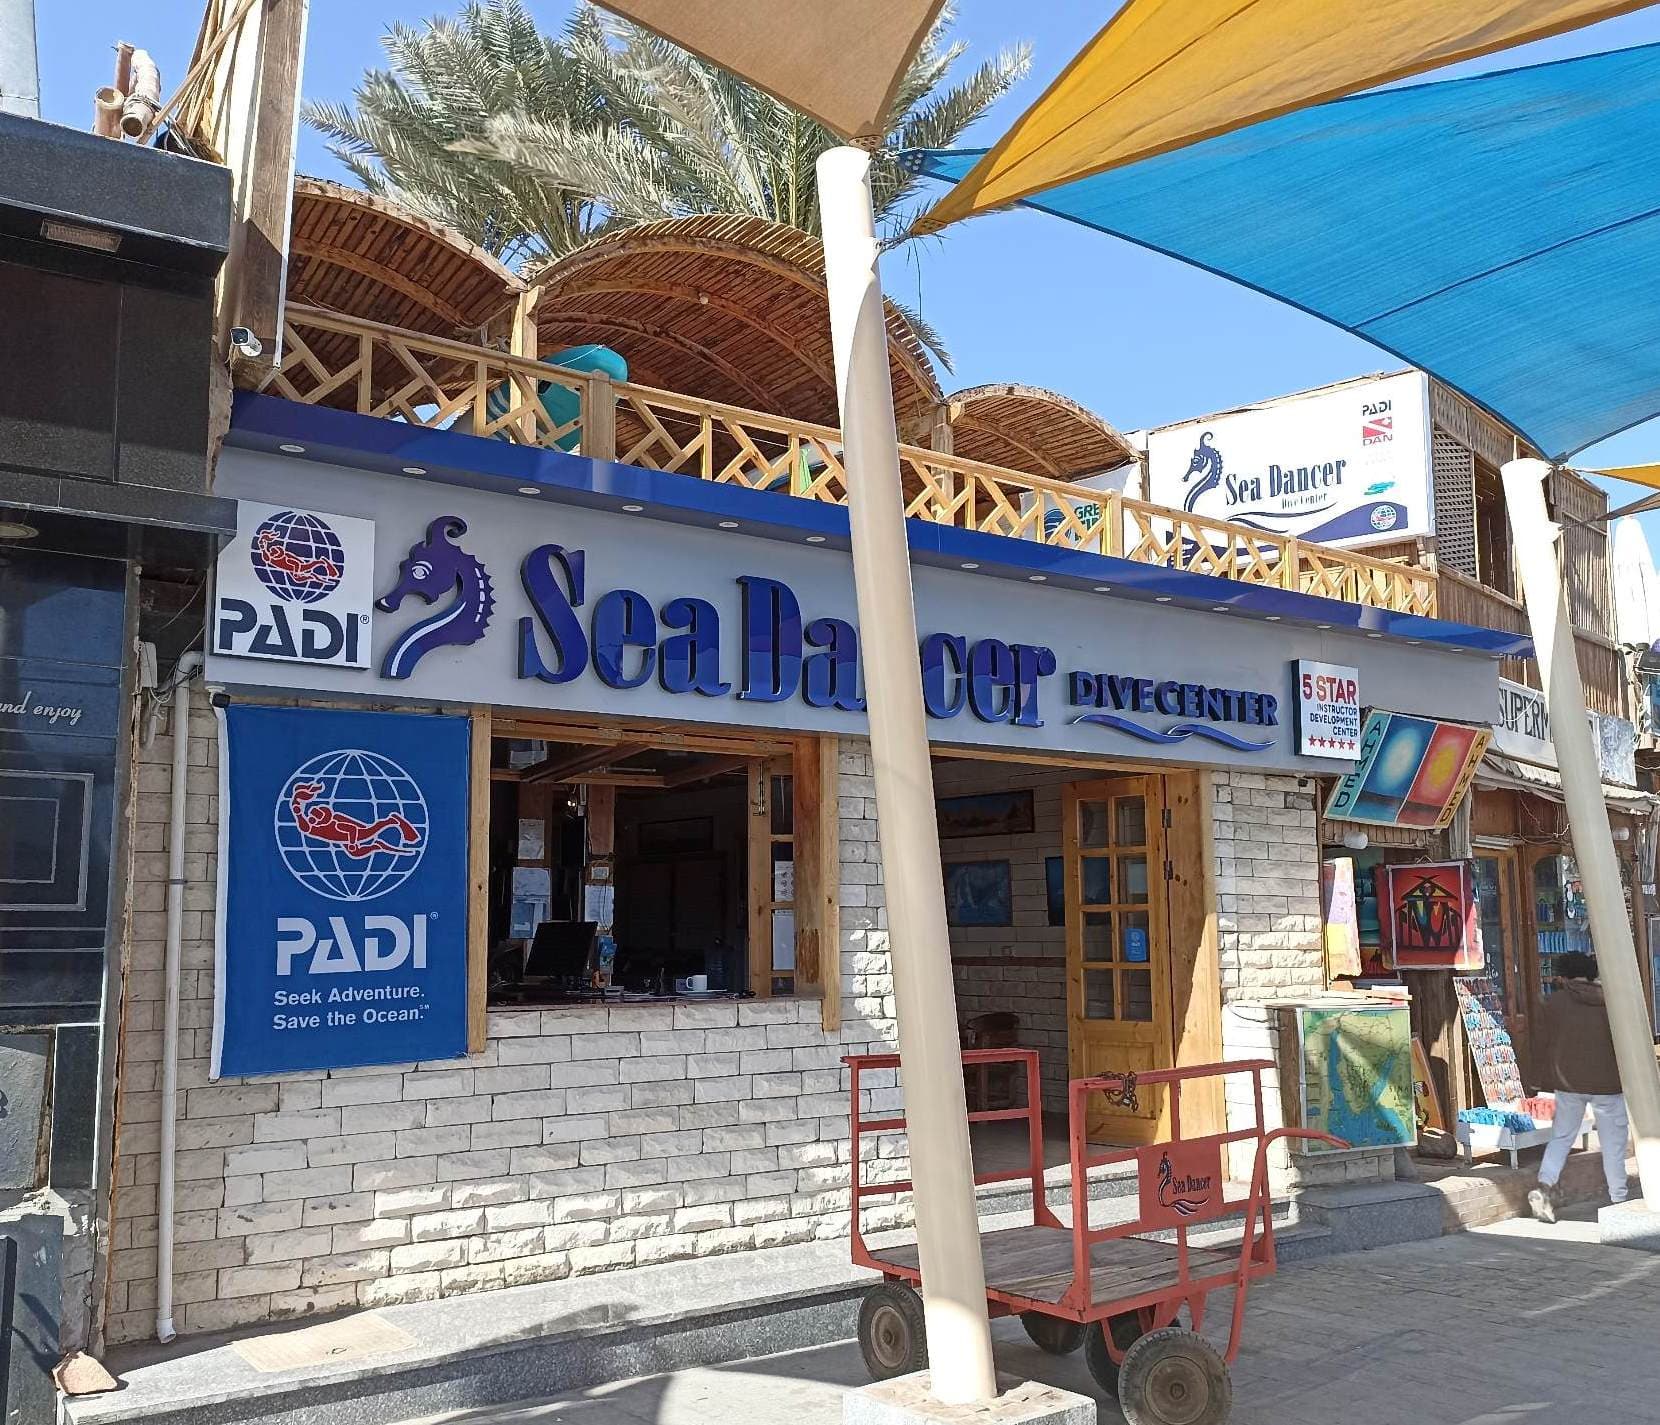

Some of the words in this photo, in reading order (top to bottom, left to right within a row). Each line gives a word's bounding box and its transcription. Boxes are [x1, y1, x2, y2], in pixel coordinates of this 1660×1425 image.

[1362, 399, 1392, 416] PADI
[1363, 434, 1393, 446] DAN
[1225, 473, 1263, 505] Sea
[1269, 460, 1347, 497] Dancer
[517, 543, 731, 698] Sea
[735, 575, 1057, 729] Dacer
[1302, 673, 1313, 700] 5
[1316, 675, 1357, 706] STAR
[33, 704, 82, 726] enjoy
[1309, 712, 1358, 728] DEVELOPMENT
[1316, 703, 1358, 716] INSTRUCTOR
[1332, 726, 1358, 738] CENTER
[1333, 720, 1382, 809] AHMED
[1439, 734, 1486, 823] AHMED
[273, 988, 322, 1006] Seek
[327, 985, 425, 1003] Adventure.
[272, 1013, 321, 1030] Save
[327, 1011, 357, 1027] the
[1172, 1176, 1186, 1195] Sea
[1186, 1174, 1212, 1192] Dancer
